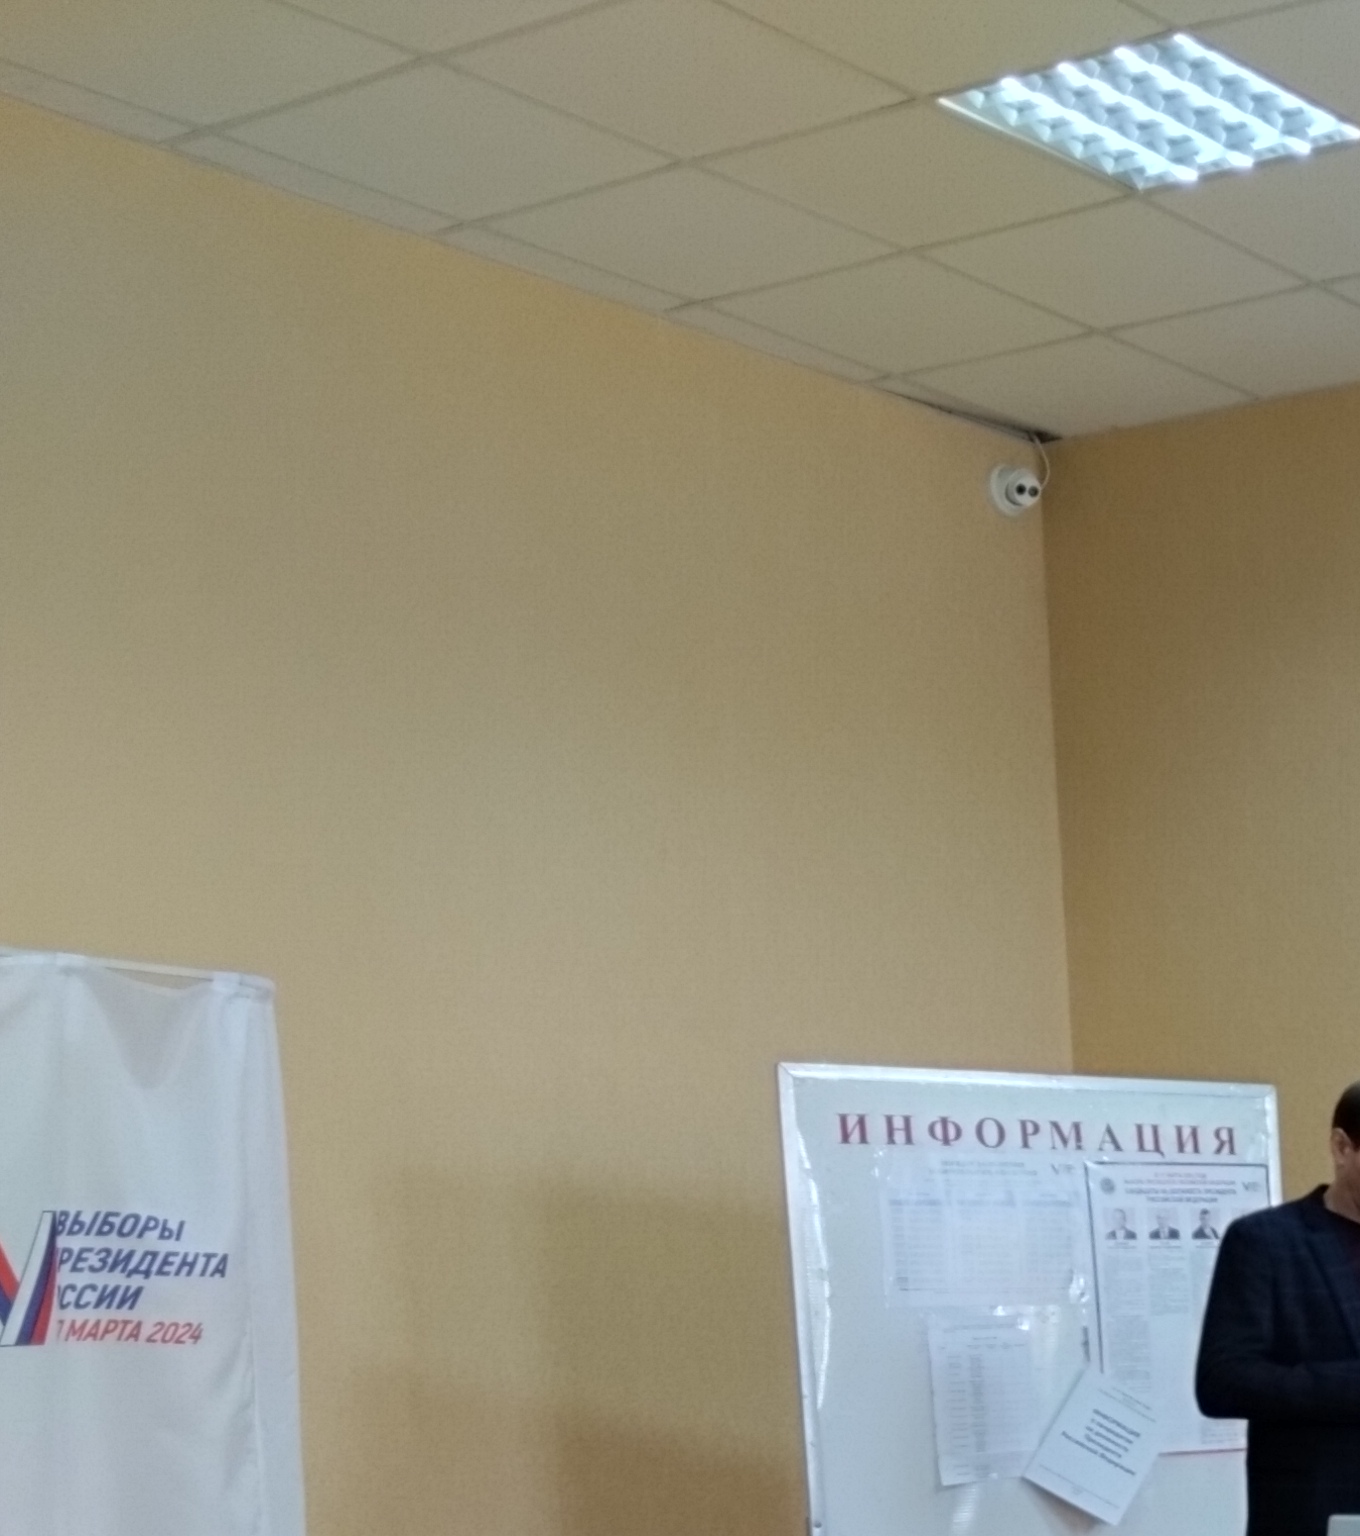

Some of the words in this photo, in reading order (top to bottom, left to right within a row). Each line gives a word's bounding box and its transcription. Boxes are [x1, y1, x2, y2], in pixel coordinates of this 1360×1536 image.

[836, 1111, 1238, 1158] ИНФОРМАЦИЯ
[56, 1210, 186, 1241] ВЫБОРЫ
[57, 1247, 229, 1279] РЕЗИДЕНТА
[58, 1283, 144, 1311] ССИИ
[65, 1319, 143, 1342] МАРТА
[146, 1321, 204, 1345] 2024
